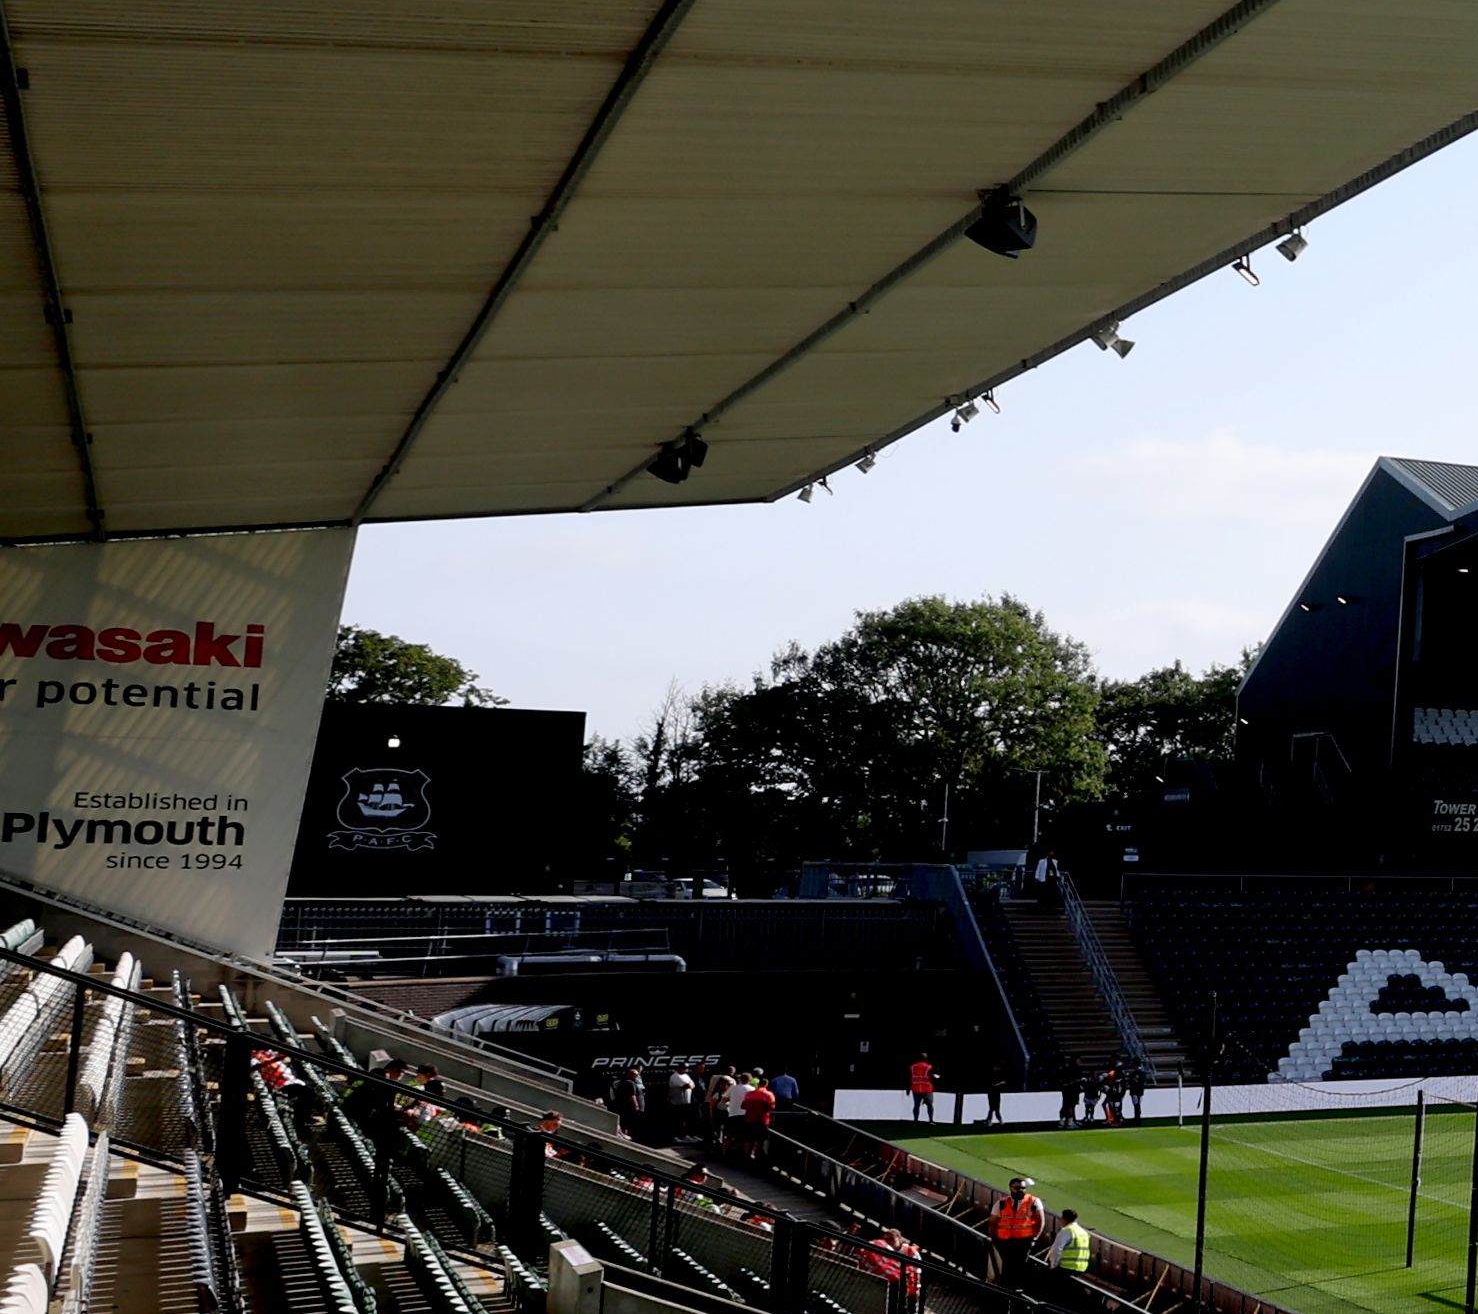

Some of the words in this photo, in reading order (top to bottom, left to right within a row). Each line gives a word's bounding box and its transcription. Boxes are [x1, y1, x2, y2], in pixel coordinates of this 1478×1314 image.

[37, 678, 260, 711] potential
[74, 792, 218, 811] Established
[228, 795, 248, 811] in
[1433, 799, 1476, 815] TOWER
[2, 812, 244, 849] Plymouth
[1432, 824, 1452, 833] 01752
[1453, 817, 1470, 833] 25
[106, 853, 169, 869] since
[181, 853, 243, 870] 1994
[591, 1054, 721, 1069] PRINCESS
